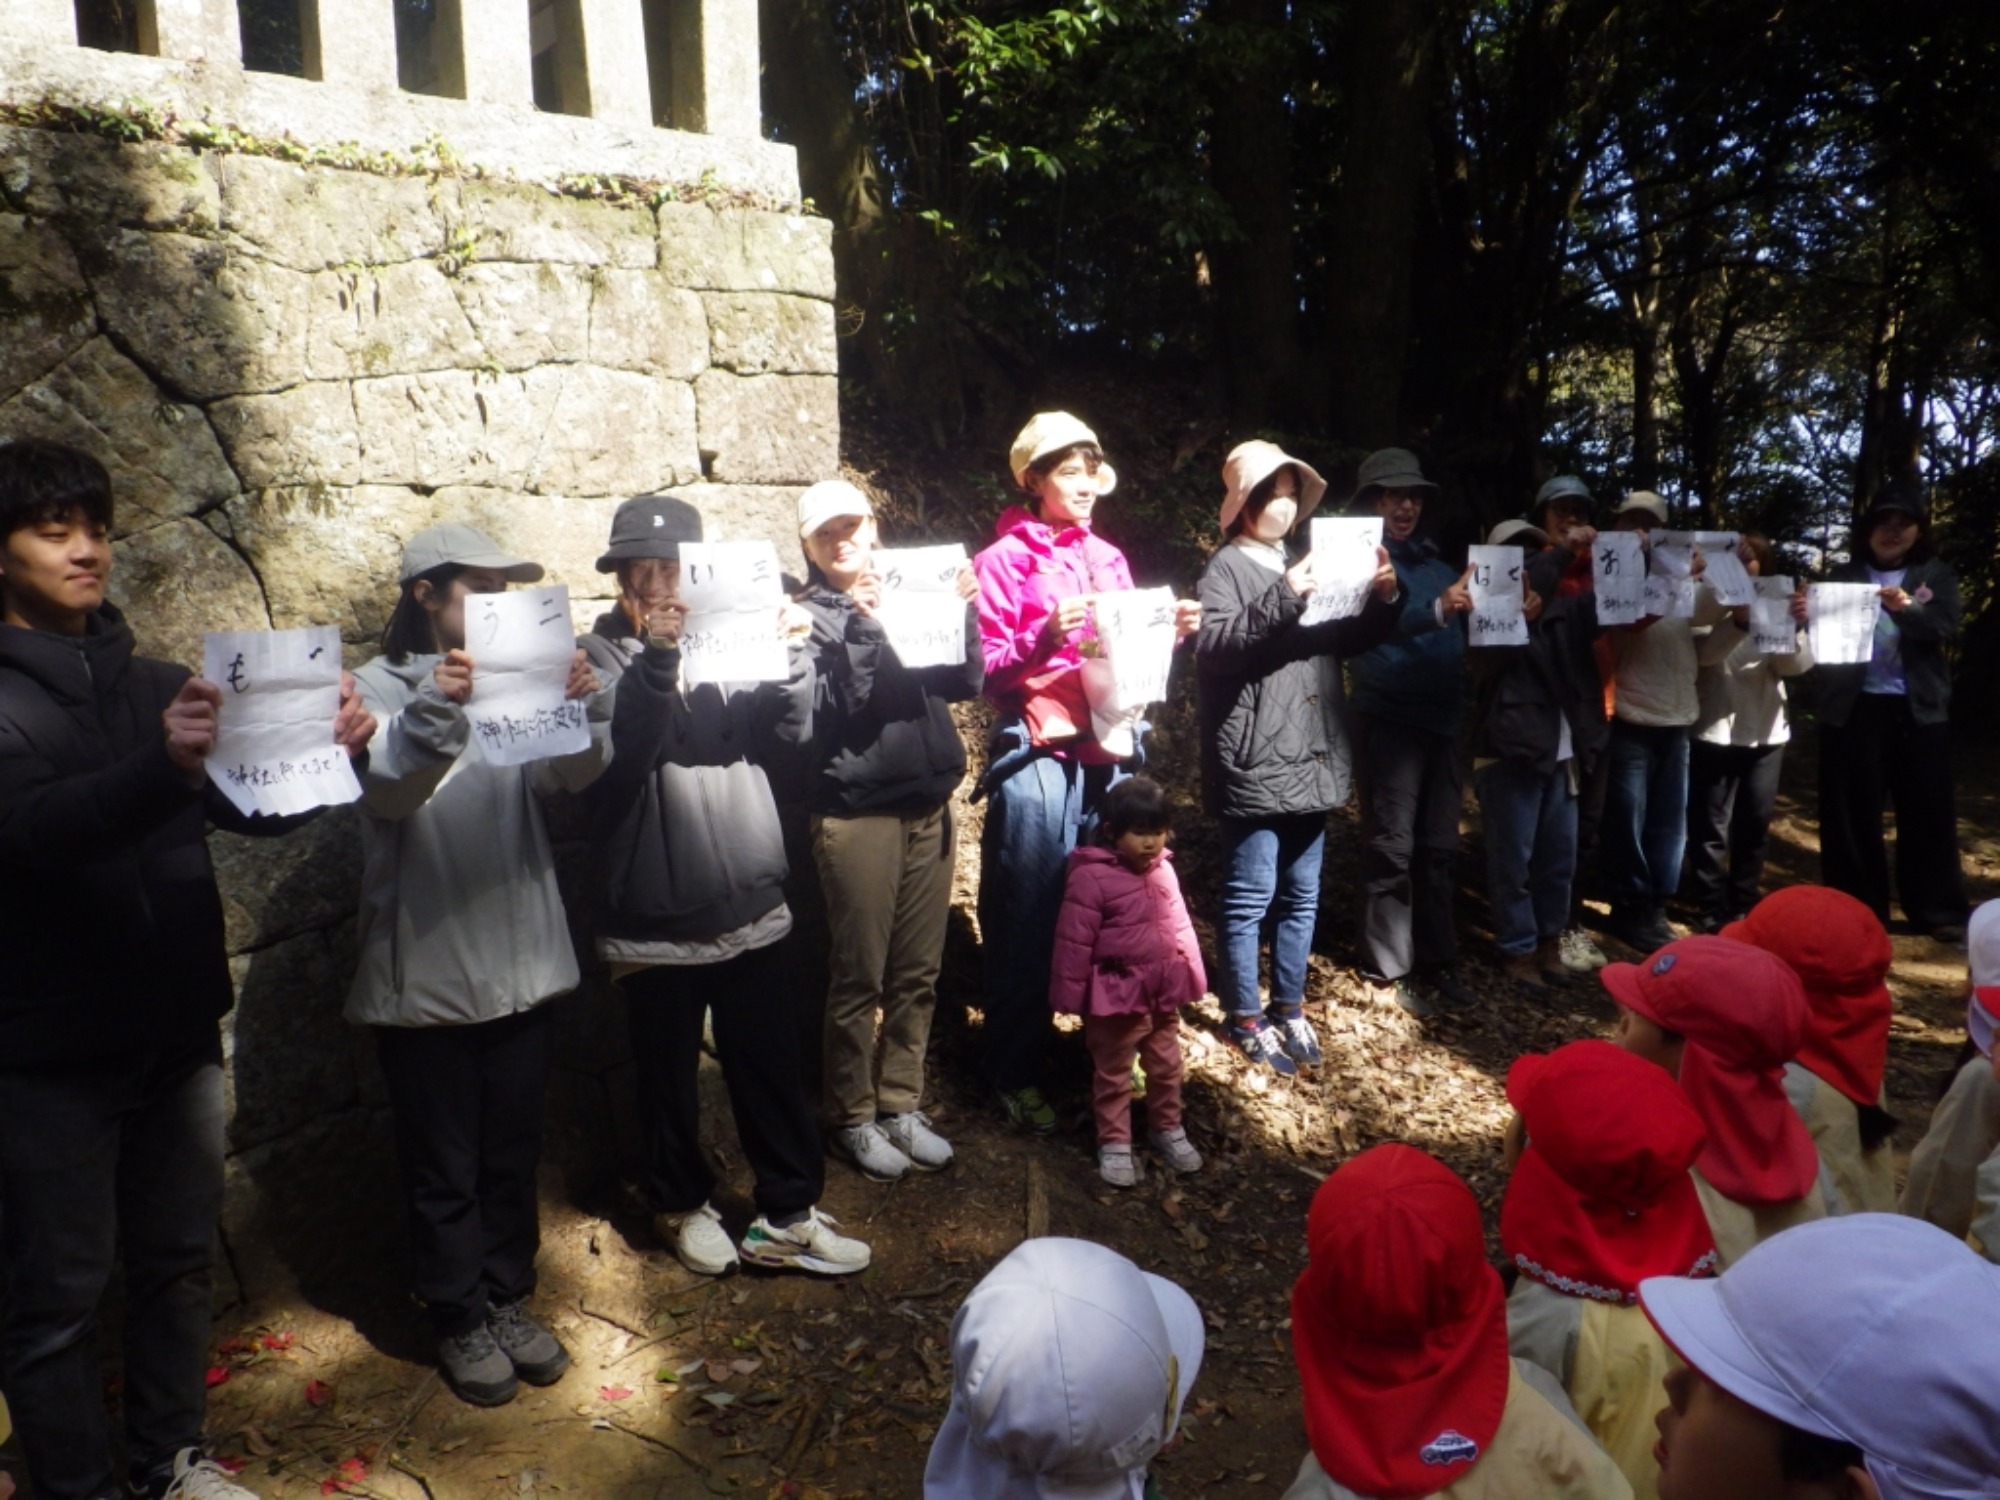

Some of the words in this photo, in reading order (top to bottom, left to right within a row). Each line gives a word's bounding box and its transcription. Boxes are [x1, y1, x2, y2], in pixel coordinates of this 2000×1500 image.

[690, 564, 714, 585] い
[752, 560, 770, 582] 三
[484, 601, 500, 645] う
[539, 598, 563, 626] 二
[227, 653, 250, 693] も
[308, 646, 323, 660] 一
